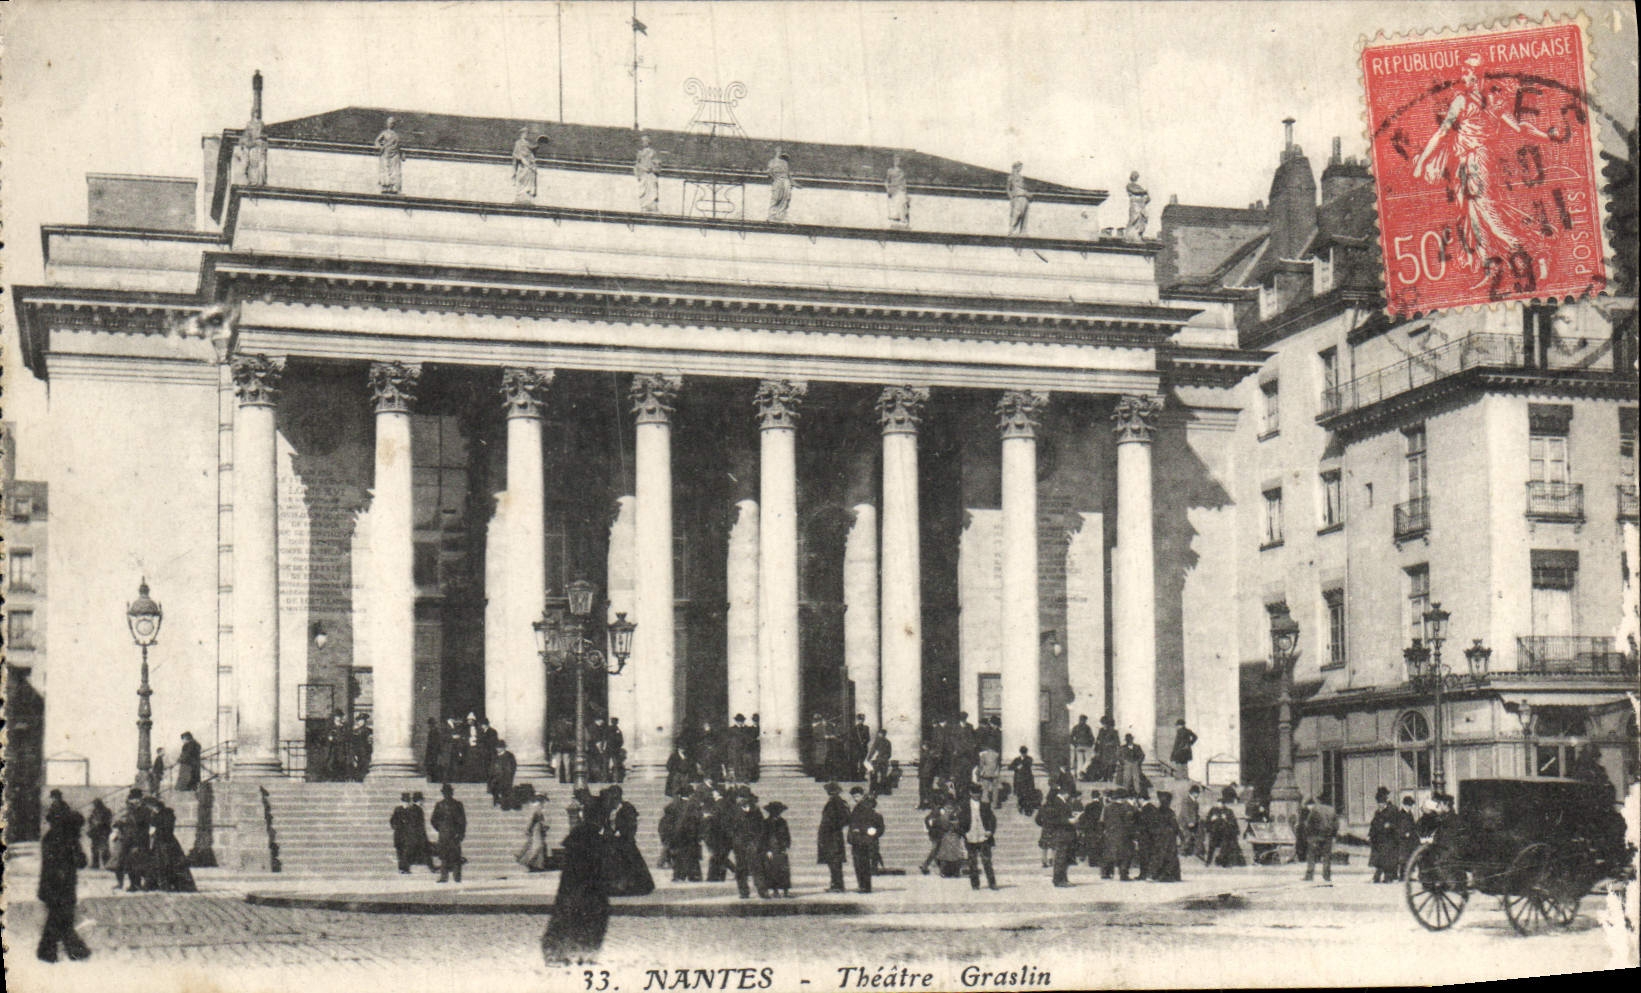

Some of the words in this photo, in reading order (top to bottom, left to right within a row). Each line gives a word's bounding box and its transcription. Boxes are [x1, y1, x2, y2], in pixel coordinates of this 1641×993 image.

[1372, 50, 1460, 76] REPUBLIQUE
[1489, 37, 1571, 63] FRANÇAISE
[1568, 191, 1592, 275] POSTES
